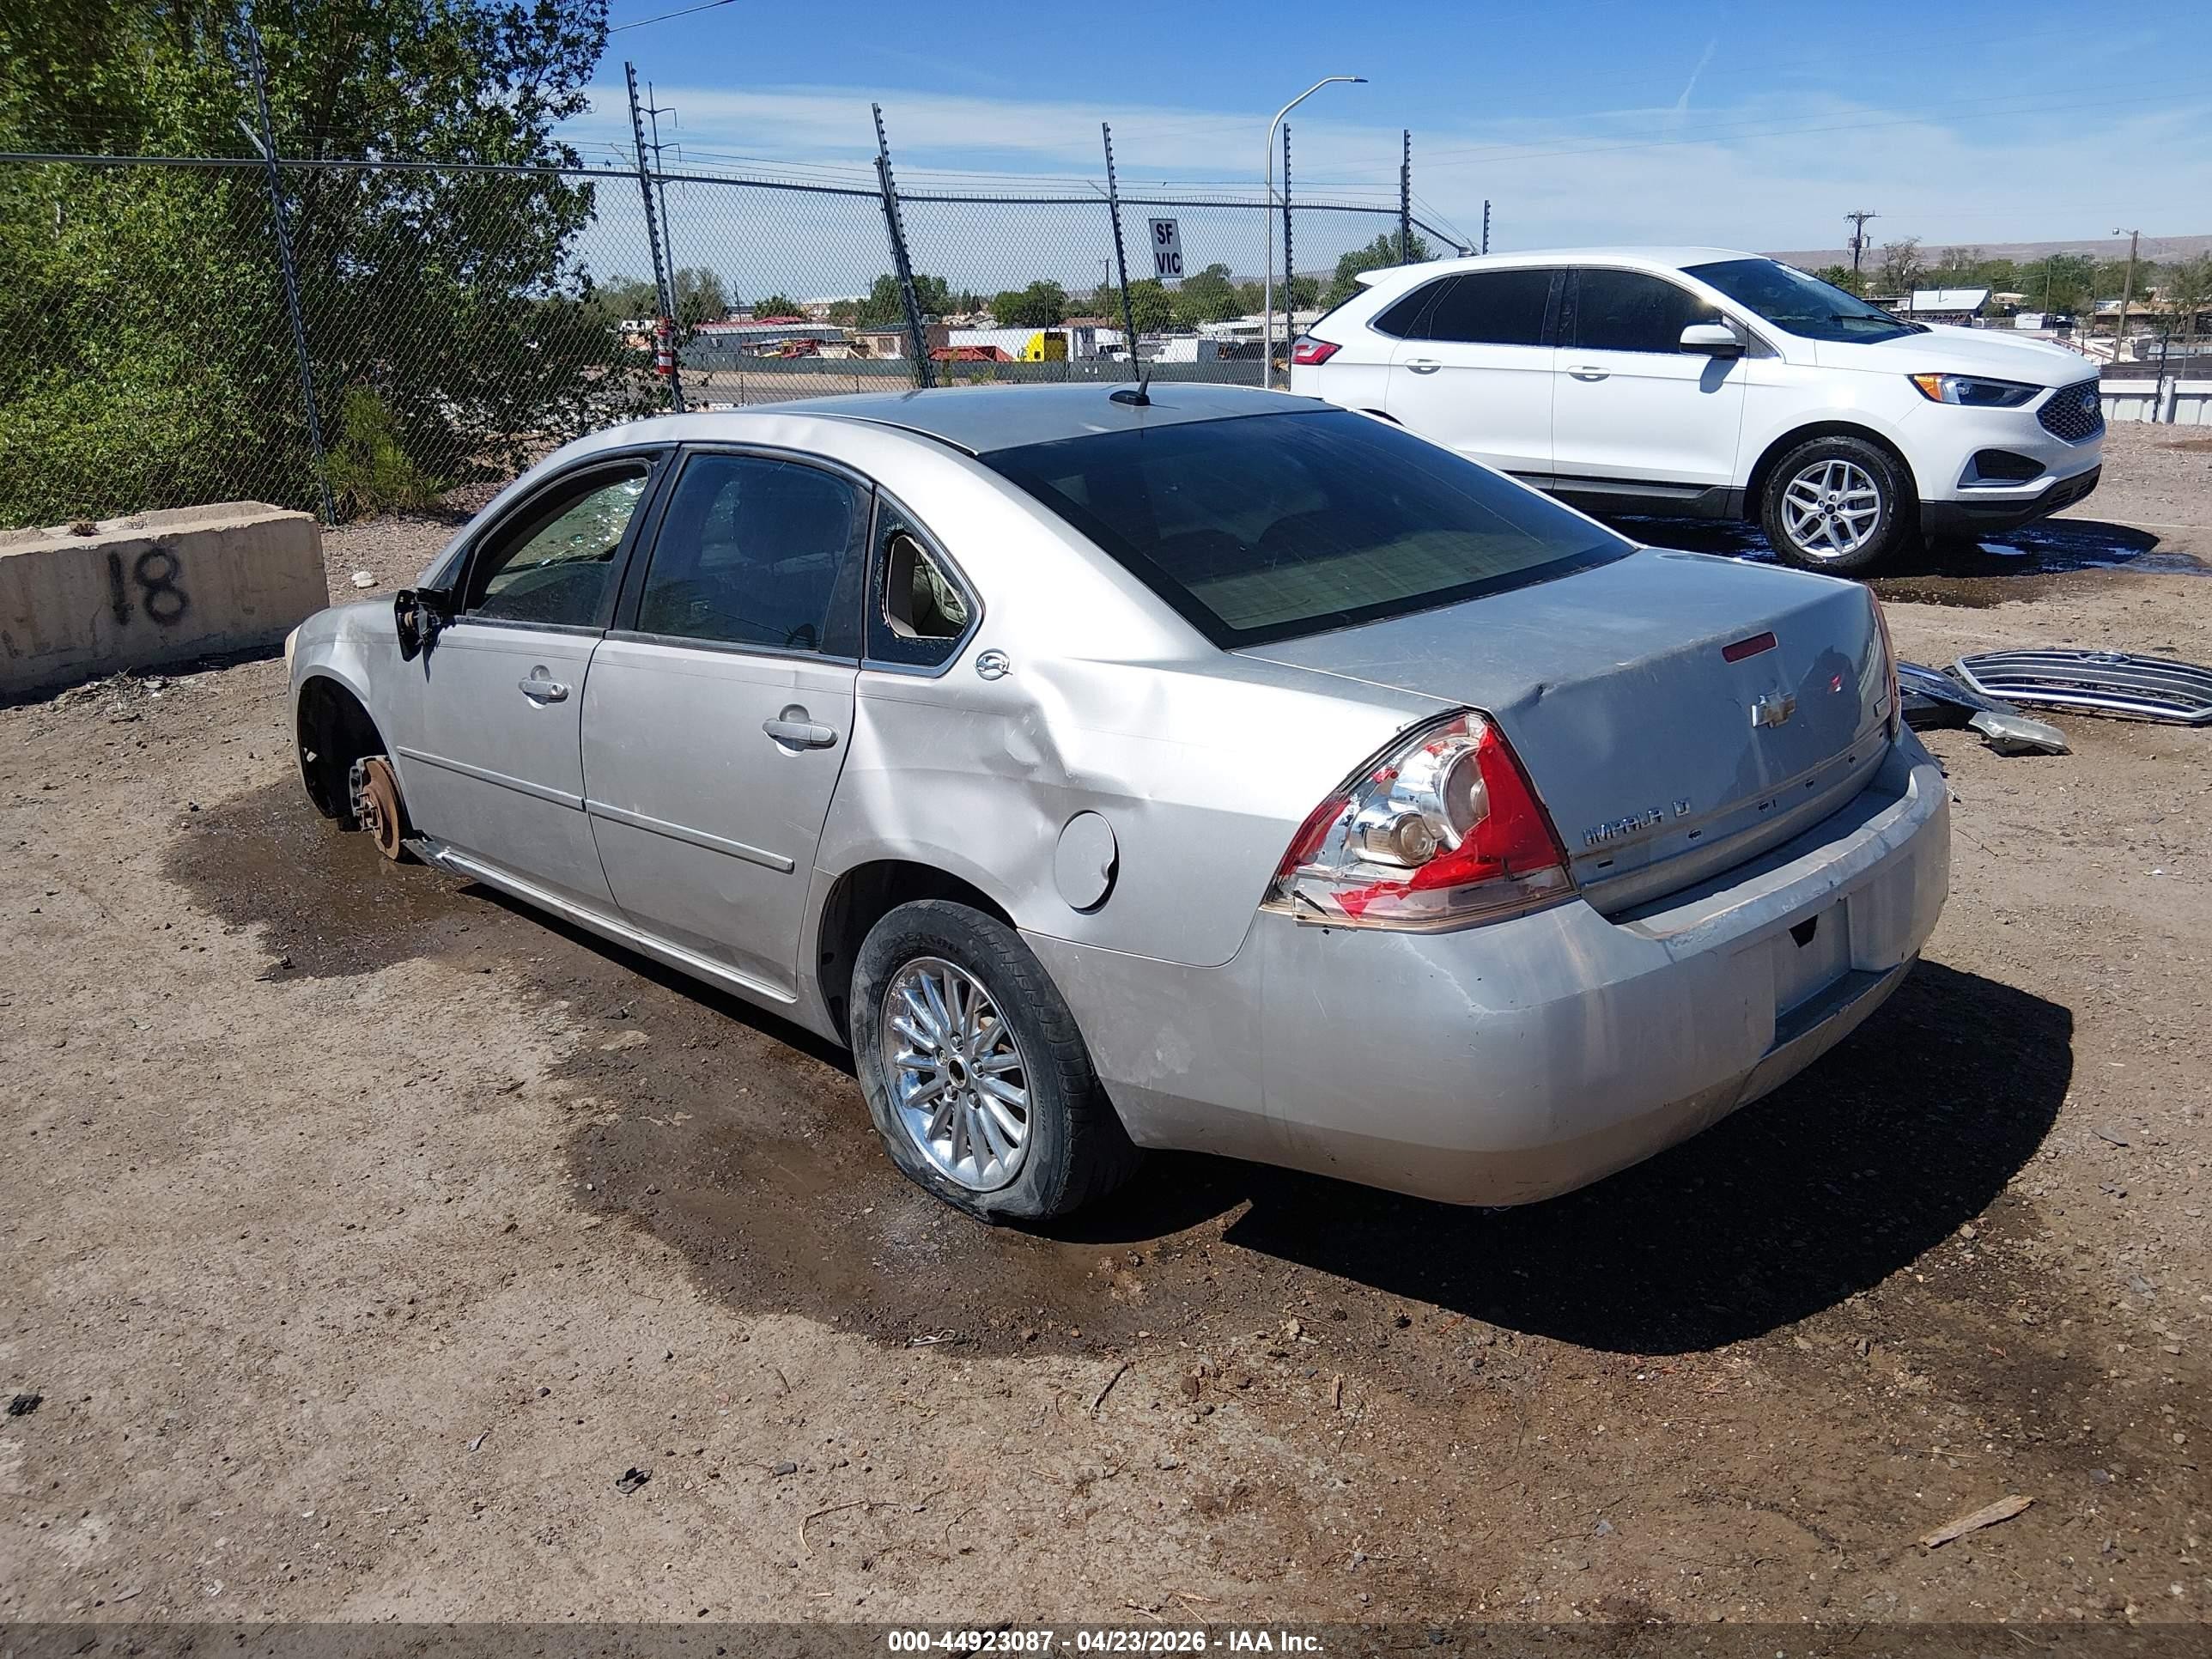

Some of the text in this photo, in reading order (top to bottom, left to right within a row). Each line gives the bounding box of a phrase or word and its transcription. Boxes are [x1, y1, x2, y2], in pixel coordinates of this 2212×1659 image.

[1156, 223, 1173, 245] SF
[1156, 252, 1181, 274] VIC
[107, 549, 190, 627] 18
[1583, 808, 1664, 846] IMPALA
